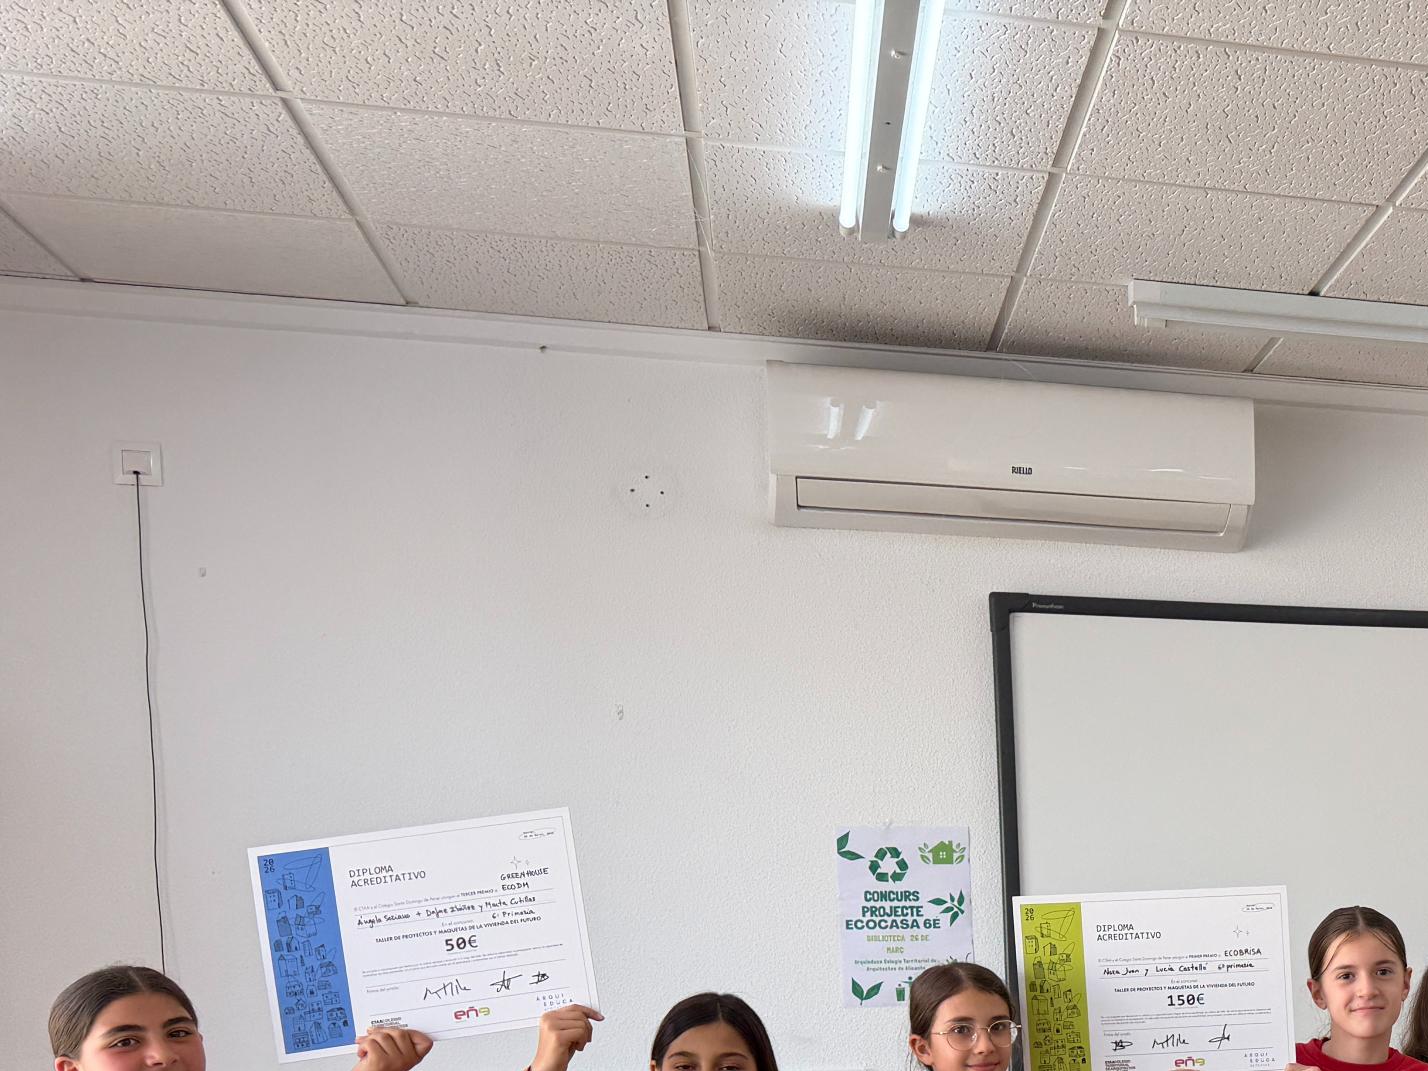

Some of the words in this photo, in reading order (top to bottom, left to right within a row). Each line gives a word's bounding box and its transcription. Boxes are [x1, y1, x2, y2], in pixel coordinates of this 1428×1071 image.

[348, 865, 394, 878] DIPLOMA
[350, 870, 426, 888] ACREDITATIVO
[864, 890, 920, 902] CONCURS
[861, 905, 924, 918] PROJECTE
[845, 919, 920, 930] ECOCASA
[1096, 924, 1134, 933] DIPLOMA
[444, 934, 478, 952] 50€
[1097, 932, 1161, 941] ACREDITATIVO
[1167, 993, 1205, 1007] 150€
